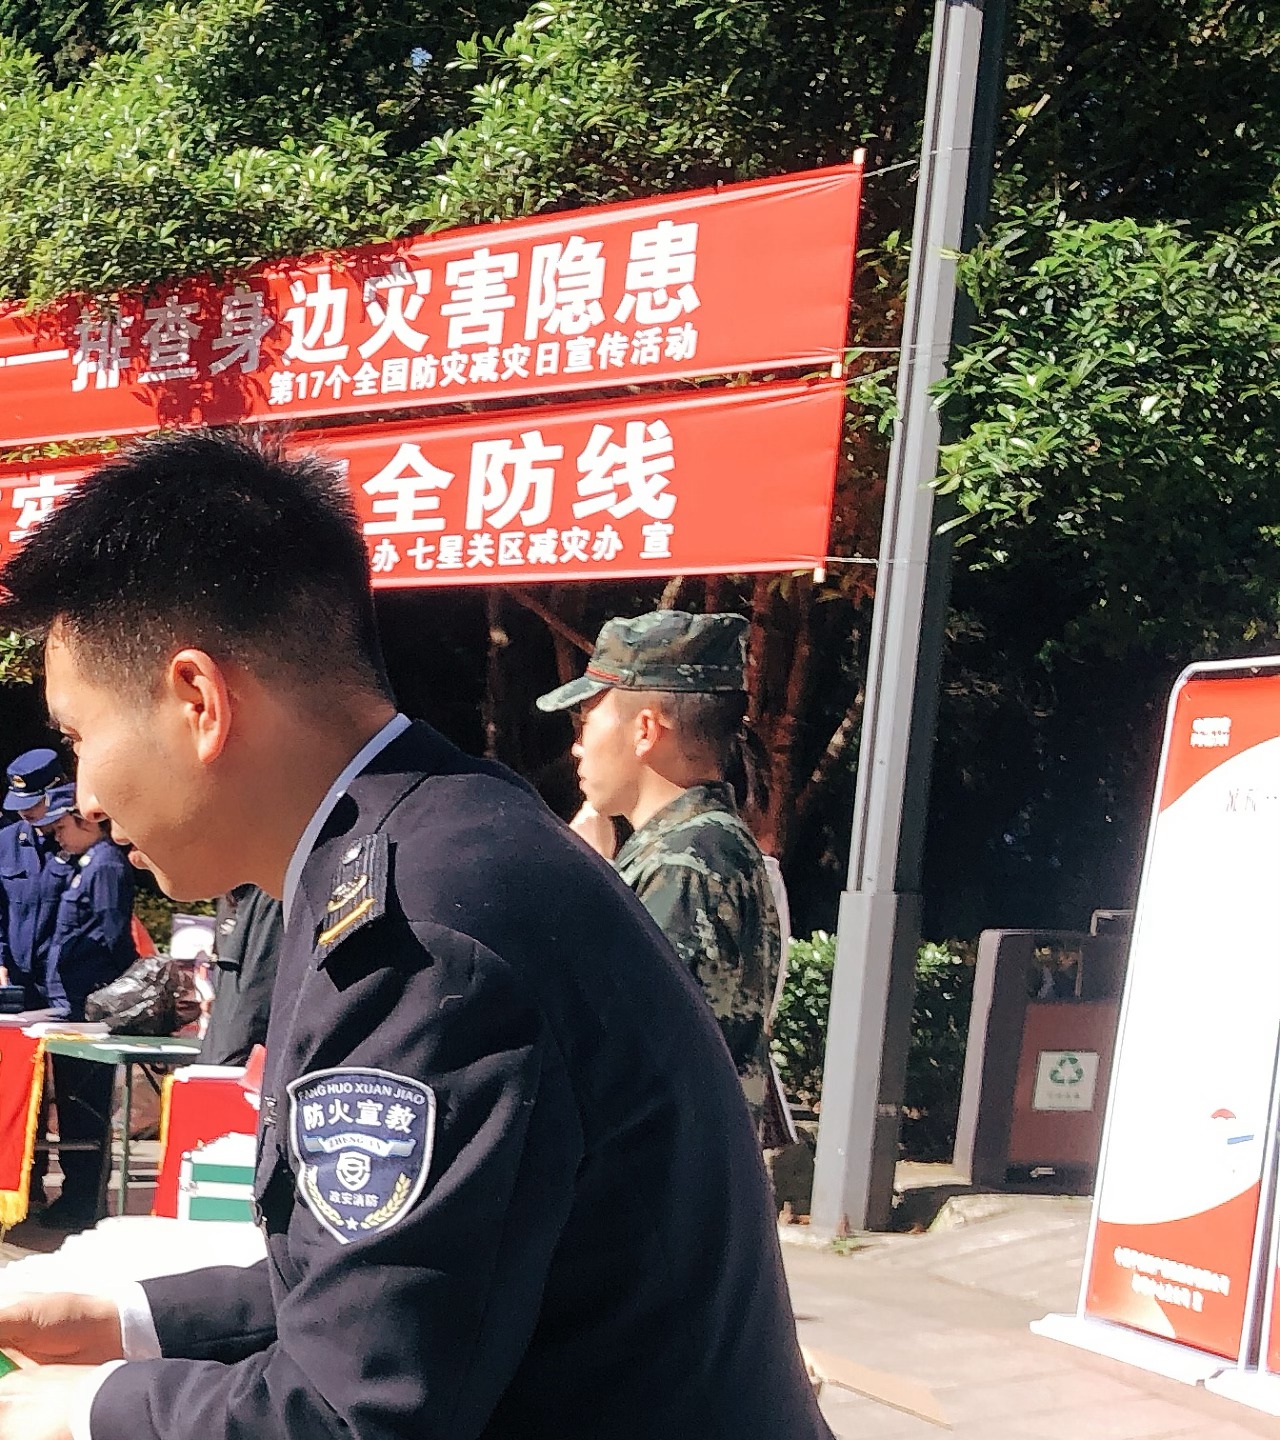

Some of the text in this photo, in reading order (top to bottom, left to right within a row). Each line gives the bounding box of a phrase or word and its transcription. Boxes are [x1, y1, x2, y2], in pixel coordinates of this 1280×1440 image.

[268, 321, 699, 406] 第17个全国防灾减灾日宣传活动
[328, 419, 679, 537] 全防线
[407, 525, 623, 573] 七星关区减灾办
[640, 523, 673, 561] 宣
[302, 1098, 417, 1134] 防火宣教
[328, 1082, 353, 1094] HUO
[355, 1082, 393, 1097] XUAN
[393, 1087, 426, 1106] JIAO
